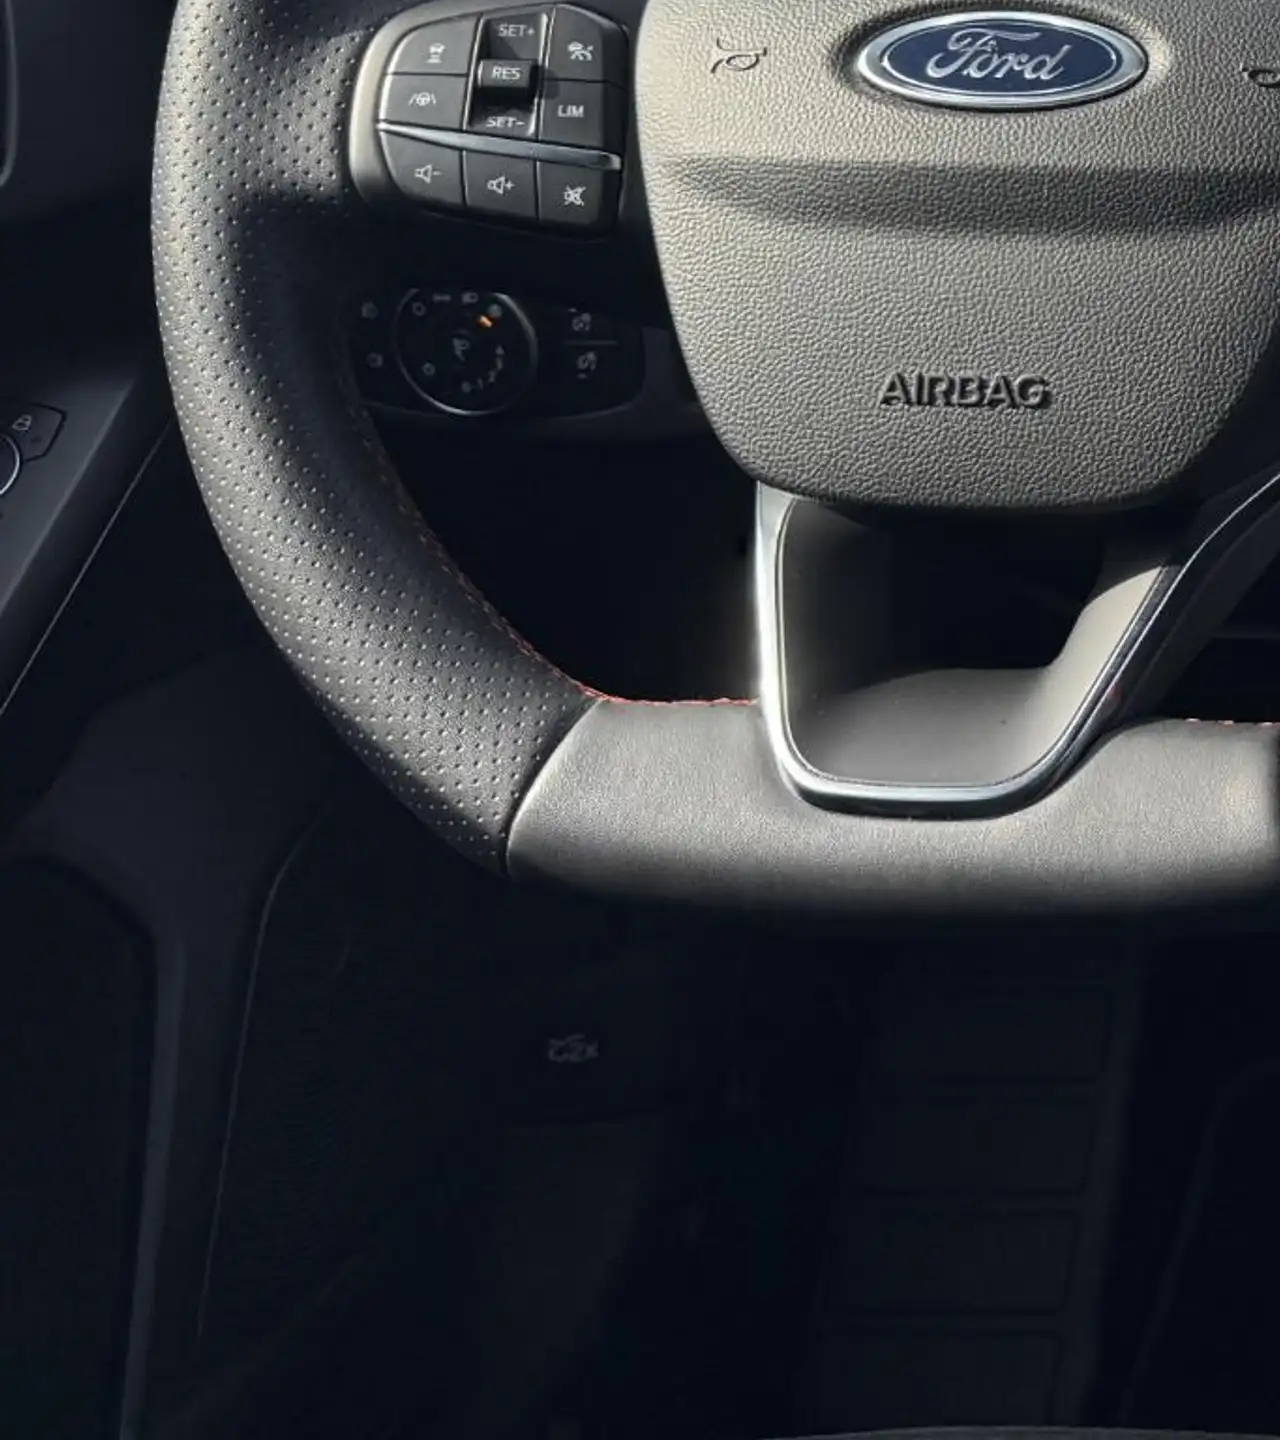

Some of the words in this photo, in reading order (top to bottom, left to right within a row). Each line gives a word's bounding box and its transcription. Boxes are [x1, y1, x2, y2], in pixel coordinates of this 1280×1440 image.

[926, 28, 1072, 81] Ford
[491, 66, 521, 80] RES
[557, 105, 585, 118] LIM
[878, 370, 1049, 410] AIRBAG
